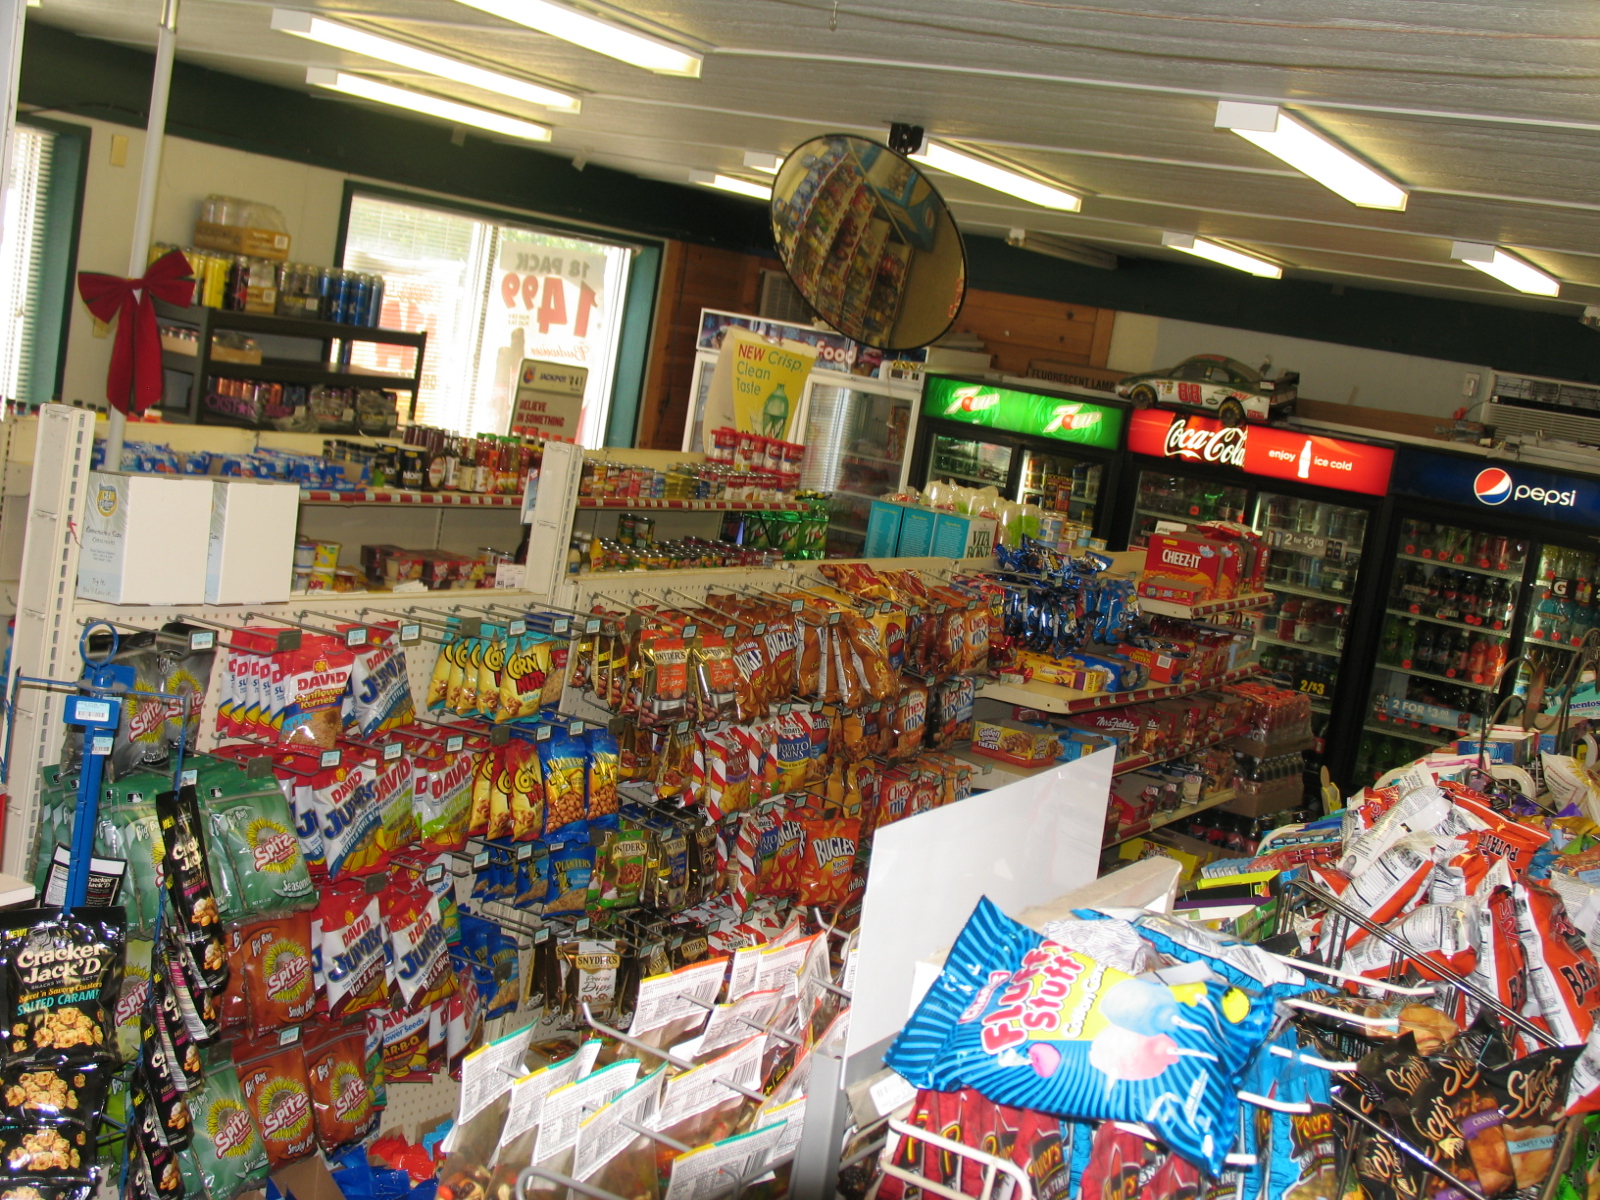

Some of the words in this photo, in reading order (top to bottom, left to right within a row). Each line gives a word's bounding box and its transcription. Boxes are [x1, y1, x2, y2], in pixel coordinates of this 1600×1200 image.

[738, 343, 766, 362] NEW
[736, 360, 771, 381] Clean
[1031, 368, 1090, 390] FLUORESCENT
[736, 377, 761, 396] Taste
[1178, 382, 1202, 404] 88
[519, 399, 548, 413] BELIEVE
[525, 413, 566, 428] SOMETHING
[1164, 419, 1248, 468] Coca-Cola
[1268, 450, 1296, 462] enjoy
[1314, 456, 1329, 467] ice
[1330, 460, 1353, 471] cold
[1514, 484, 1576, 507] pepsi
[973, 531, 991, 547] VITA
[1284, 533, 1293, 546] 2
[1162, 549, 1202, 569] CHEEZ-IT
[655, 651, 686, 660] SNYDER'S
[507, 653, 540, 680] CORN
[297, 671, 348, 691] DAVID
[516, 669, 546, 695] NUTS
[660, 677, 683, 690] Dips
[1300, 680, 1326, 695] 2/$3
[295, 687, 346, 703] Sunflower
[301, 696, 336, 709] Kernels
[1391, 699, 1401, 710] 2
[1402, 701, 1425, 714] FOR
[128, 698, 164, 742] Spitz
[778, 741, 811, 754] POTATO
[781, 750, 804, 760] SKINS
[978, 741, 999, 751] TREATS
[330, 772, 363, 804] DAVID
[252, 832, 297, 873] Spitz
[811, 837, 856, 869] BUGLES
[554, 859, 591, 873] PLANTERS
[341, 915, 371, 948] DAVID
[17, 943, 102, 968] Cracker
[577, 955, 618, 964] SNYDER'S
[23, 957, 102, 983] Jack'D
[267, 956, 310, 1001] Spitz
[349, 981, 364, 998] Hot
[581, 982, 612, 993] Dips
[17, 996, 55, 1016] SALTED
[115, 980, 150, 1026] Spit
[334, 1078, 366, 1122] Spitz
[262, 1092, 309, 1140] Spitz
[214, 1110, 250, 1159] Spitz
